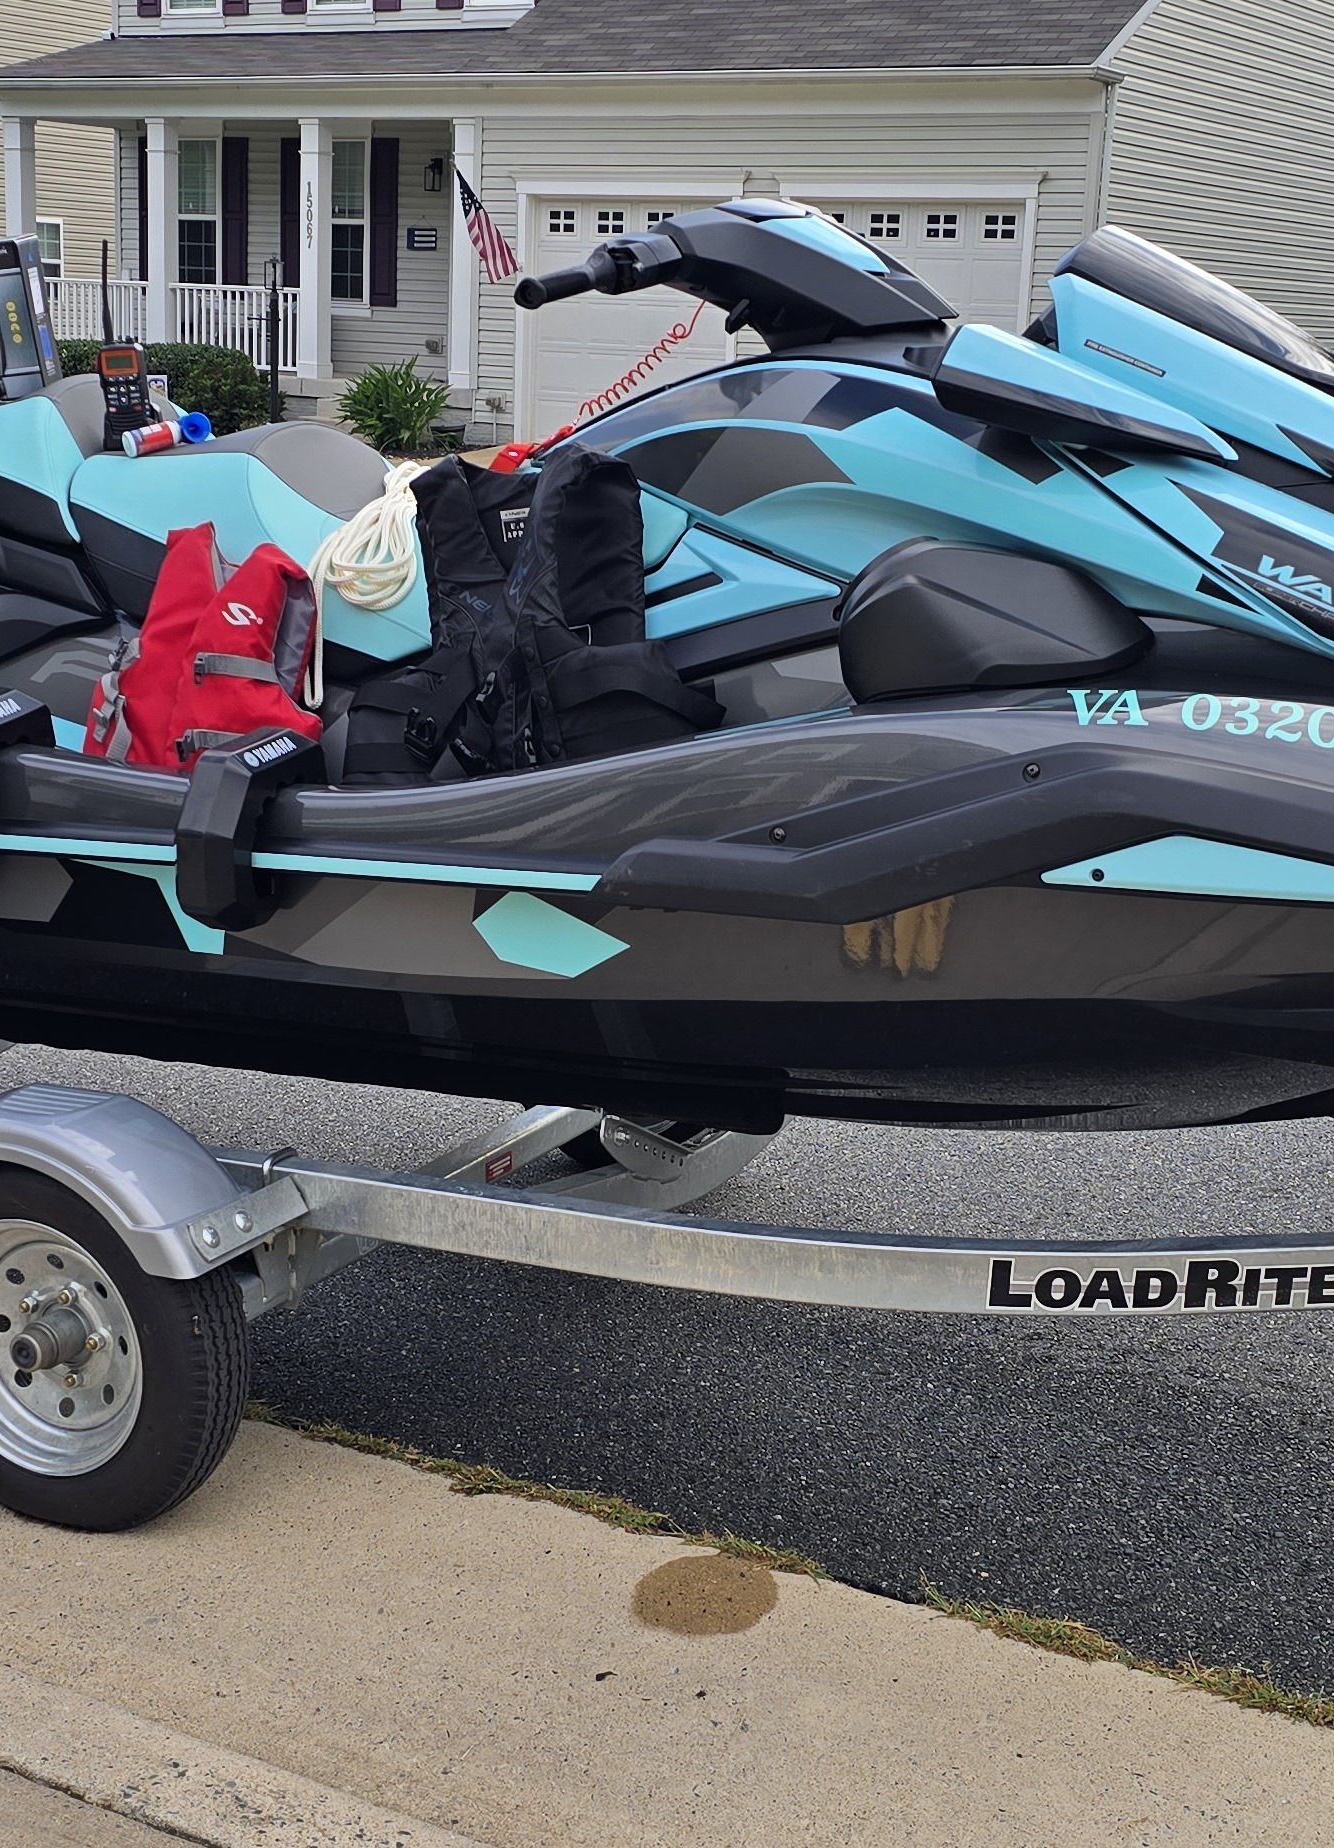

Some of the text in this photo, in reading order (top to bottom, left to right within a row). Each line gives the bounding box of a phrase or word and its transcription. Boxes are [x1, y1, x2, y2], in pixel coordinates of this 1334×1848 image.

[306, 181, 314, 249] 15067
[1067, 689, 1149, 726] VA
[251, 736, 297, 764] YAMAHA
